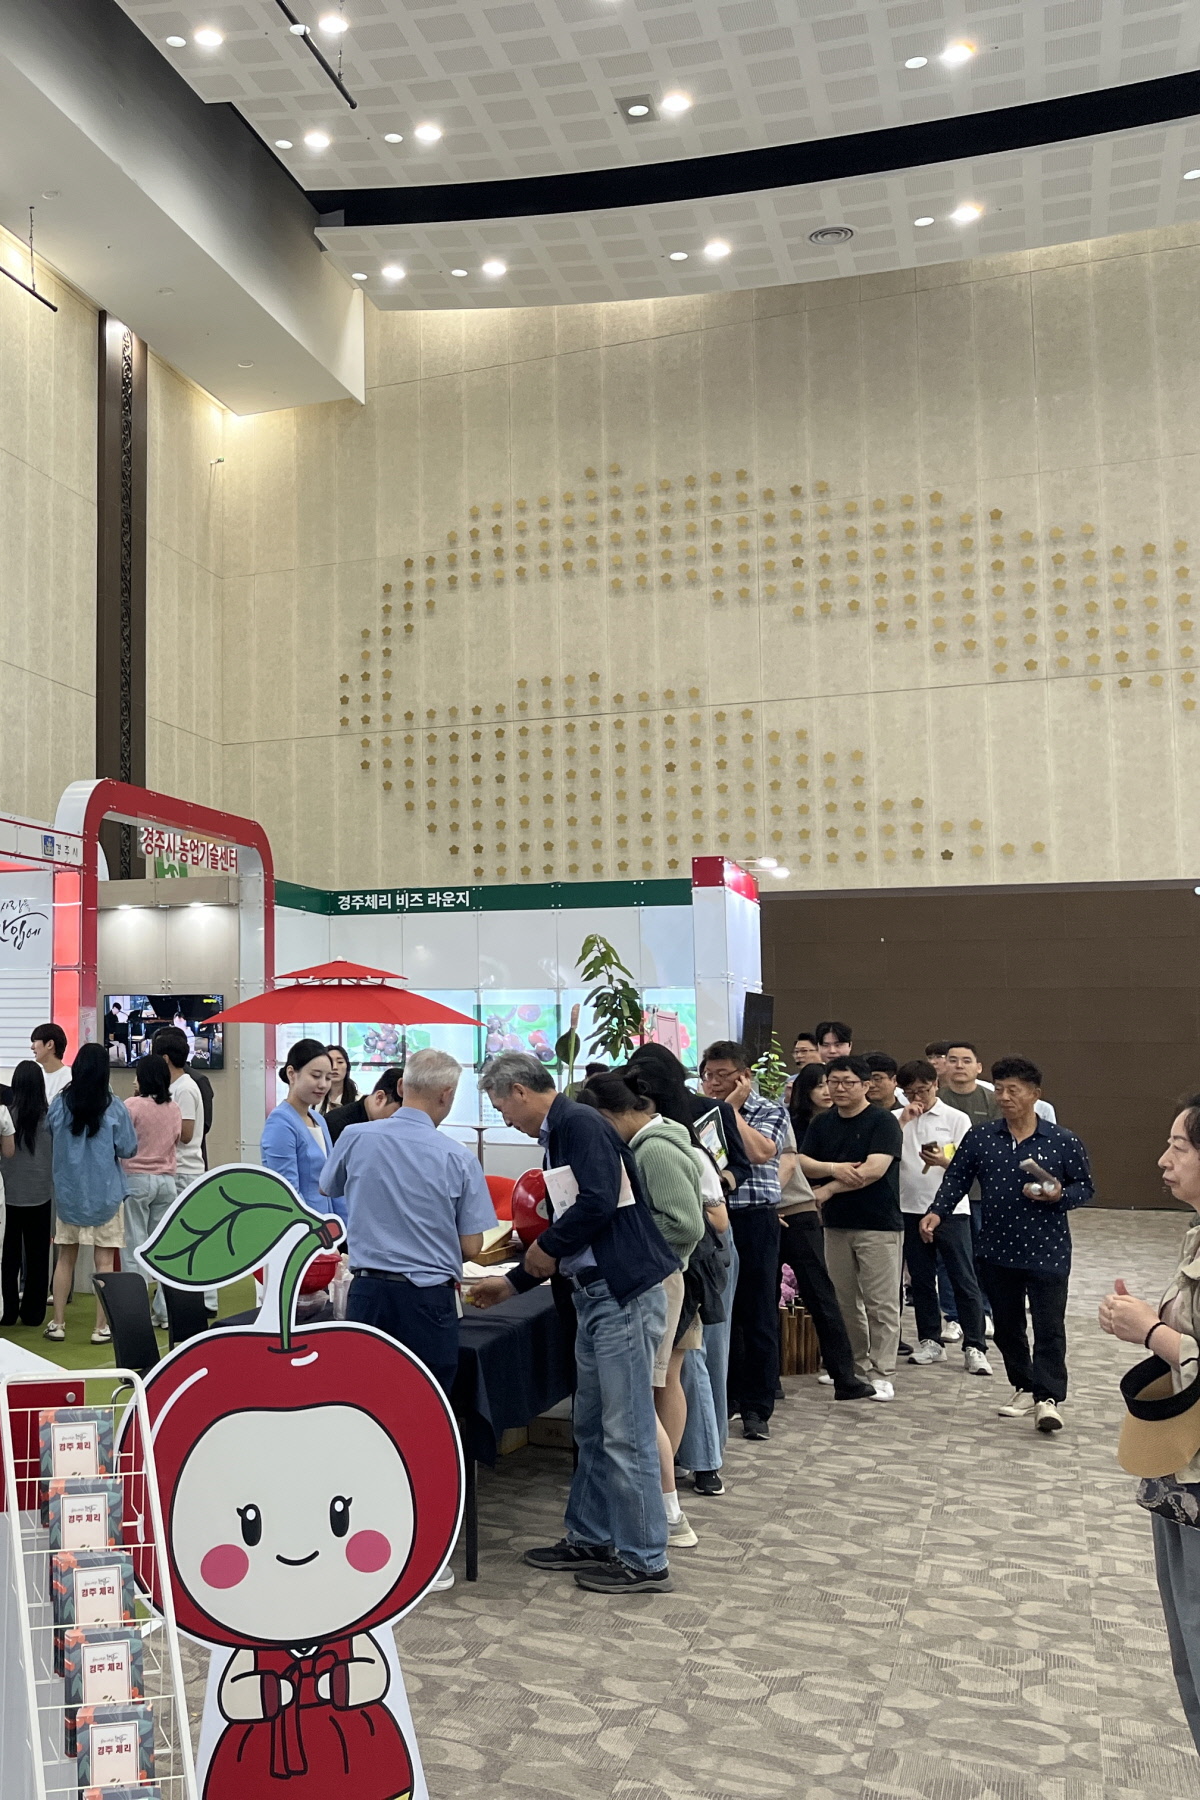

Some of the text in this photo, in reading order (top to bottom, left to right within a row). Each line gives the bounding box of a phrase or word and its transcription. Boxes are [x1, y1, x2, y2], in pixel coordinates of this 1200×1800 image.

[140, 827, 238, 874] 경주시 농업기술센터
[338, 890, 470, 910] 경주체리 비즈 라운지
[59, 1441, 91, 1452] 경주 체리
[68, 1513, 101, 1523] 경주 체리
[81, 1586, 115, 1597] 경주 체리
[89, 1662, 123, 1674] 경주 체리
[97, 1744, 132, 1756] 경주 체리
